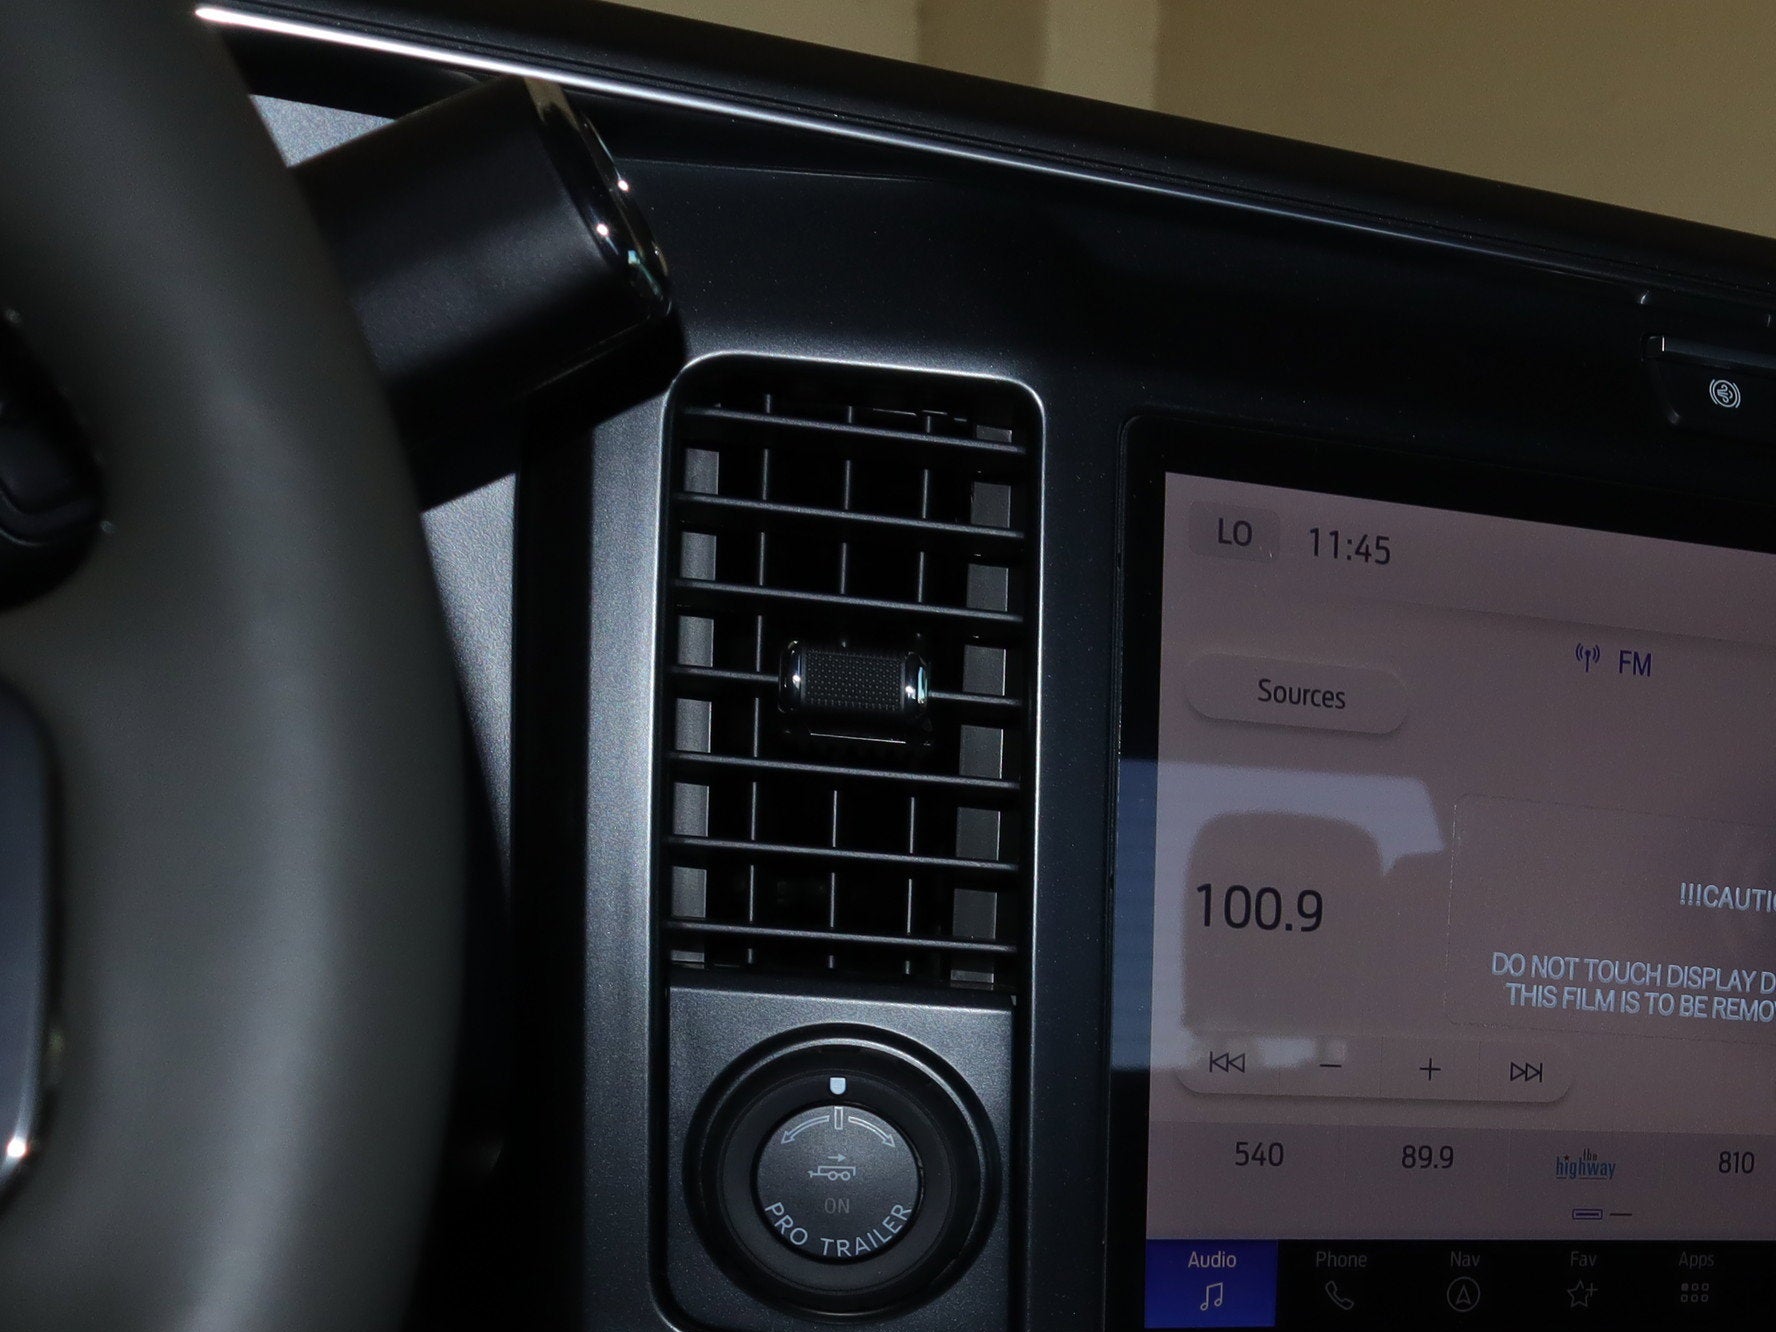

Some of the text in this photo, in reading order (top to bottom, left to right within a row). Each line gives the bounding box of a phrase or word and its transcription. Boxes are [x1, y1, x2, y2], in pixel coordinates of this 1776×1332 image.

[1217, 518, 1253, 547] LO
[1309, 527, 1391, 565] 11:45
[1619, 651, 1652, 676] FM
[1257, 678, 1347, 710] Sources
[1196, 883, 1324, 932] 100.9
[1491, 952, 1526, 977] DO
[1530, 955, 1580, 981] NOT
[1584, 957, 1662, 987] TOUCH
[1666, 964, 1757, 994] DISPLAY
[1505, 982, 1558, 1009] THIS
[1562, 986, 1615, 1013] FILM
[1620, 990, 1641, 1014] IS
[1644, 992, 1676, 1017] TO
[1679, 994, 1709, 1019] BE
[1234, 1141, 1285, 1167] 540
[1401, 1145, 1455, 1169] 89.9
[1718, 1151, 1755, 1175] 810
[1556, 1155, 1616, 1180] highway
[824, 1198, 850, 1214] ON
[764, 1201, 912, 1257] PRO TRAILER
[1187, 1250, 1237, 1269] Audio
[1315, 1250, 1368, 1268] Phone
[1449, 1250, 1481, 1268] Nav
[1569, 1250, 1598, 1268] Fav
[1678, 1251, 1715, 1271] Apps
